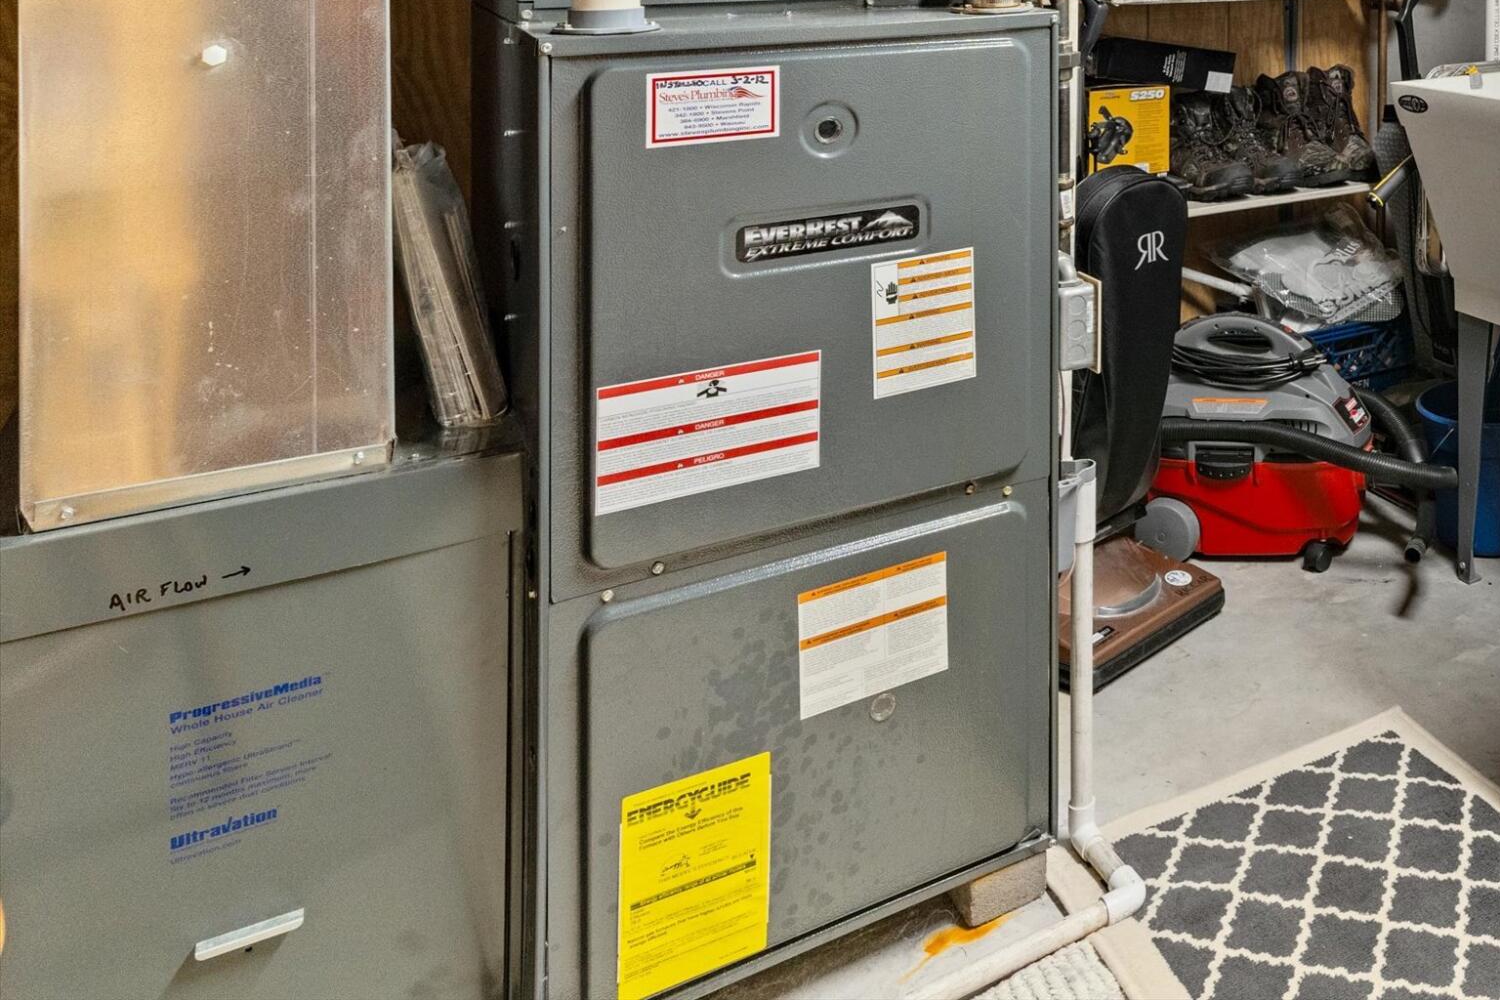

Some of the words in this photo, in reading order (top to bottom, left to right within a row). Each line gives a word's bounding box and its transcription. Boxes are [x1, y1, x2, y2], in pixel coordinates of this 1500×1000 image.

[659, 90, 688, 103] Steve's
[1130, 89, 1165, 102] S250
[745, 239, 827, 262] EXTREME
[695, 369, 725, 381] DANGER
[694, 419, 725, 431] DANGER
[693, 452, 725, 465] PELIGRO
[108, 588, 152, 611] AIR
[160, 575, 208, 597] FLOW
[170, 718, 210, 735] Whole
[213, 708, 253, 725] House
[256, 699, 274, 711] Air
[277, 687, 324, 706] Cleaner
[626, 773, 751, 827] ENERGYGUIDE
